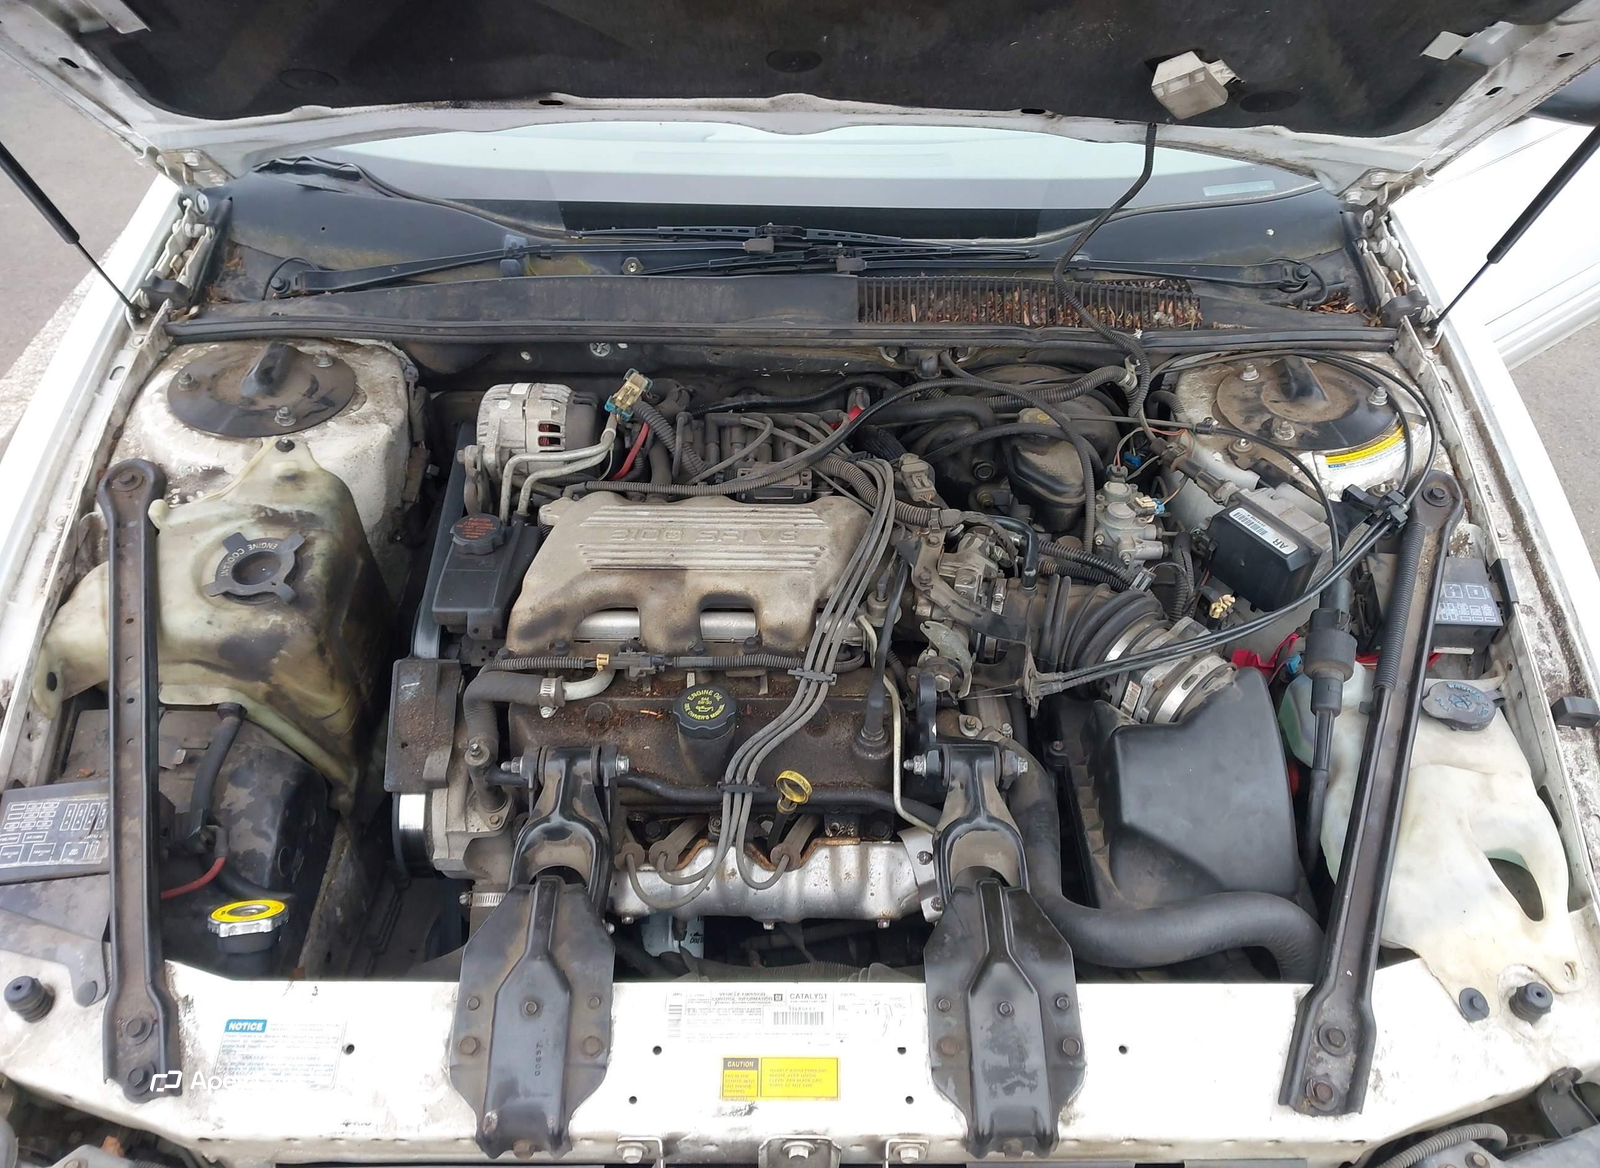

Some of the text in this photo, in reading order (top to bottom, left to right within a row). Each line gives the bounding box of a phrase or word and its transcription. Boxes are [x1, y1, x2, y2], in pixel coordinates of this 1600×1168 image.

[246, 542, 279, 551] ENGINE
[1272, 538, 1289, 549] AR
[687, 689, 723, 701] ENGINE OIL
[789, 992, 828, 1001] CATALYST
[228, 1021, 264, 1031] NOTICE
[727, 1060, 754, 1068] CAUTION
